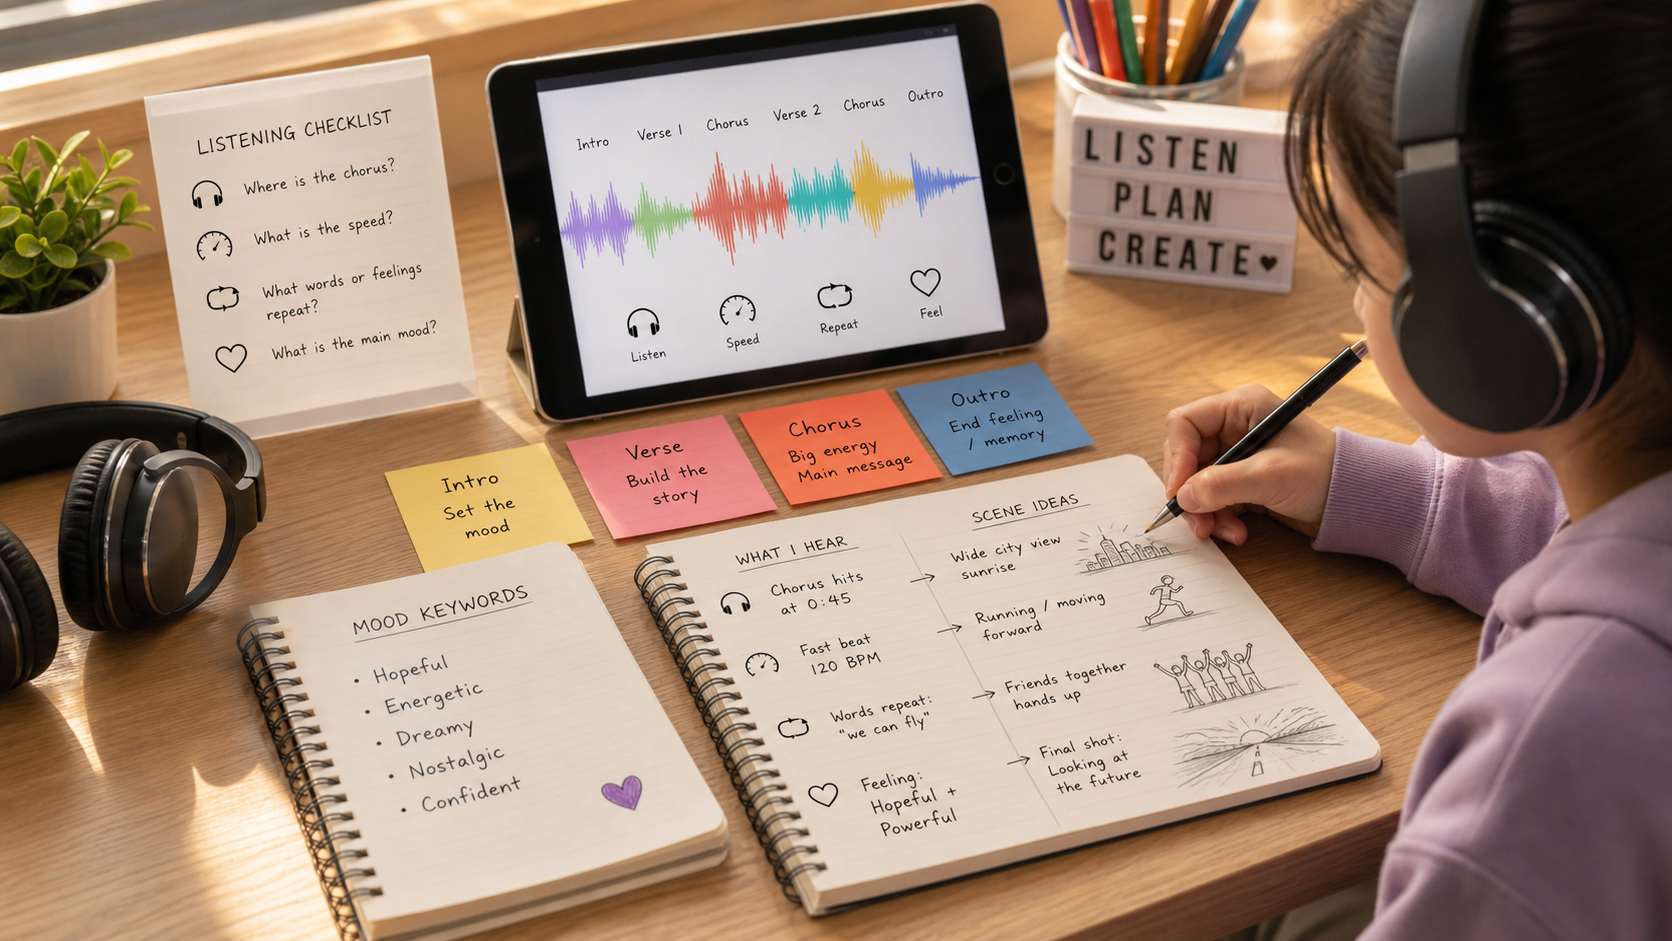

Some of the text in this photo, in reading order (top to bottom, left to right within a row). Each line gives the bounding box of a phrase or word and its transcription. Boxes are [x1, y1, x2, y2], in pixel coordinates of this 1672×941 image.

[843, 97, 886, 112] Chorus
[907, 88, 944, 103] Outro
[706, 117, 750, 132] Chorus
[772, 103, 822, 122] Verse 2
[196, 108, 392, 156] LISTENING CHECKLIST
[575, 137, 610, 151] Intro
[636, 123, 683, 142] Verse 1
[1084, 128, 1238, 174] LISTEN
[243, 156, 395, 196] Where is the chorus?
[1113, 180, 1213, 223] PLAN
[253, 209, 393, 246] What is the speed?
[1098, 228, 1251, 277] CREATE
[261, 263, 423, 299] What words or feelings
[266, 298, 319, 324] repeat?
[919, 304, 944, 320] Feel
[271, 319, 437, 361] What is the main mood?
[819, 318, 859, 337] Repeat
[726, 332, 761, 352] Speed
[630, 349, 667, 363] Listen
[951, 389, 1011, 407] Outro
[788, 417, 862, 437] Chorus
[948, 408, 1044, 433] End feeling
[624, 443, 684, 461] Verse
[969, 429, 1045, 451] / memory
[787, 440, 877, 466] Big energy
[626, 464, 709, 489] Build the
[797, 455, 913, 484] Main message
[440, 474, 499, 494] Intro
[443, 497, 516, 521] Set the
[652, 489, 699, 505] story
[971, 493, 1079, 524] SCENE IDEAS
[464, 518, 511, 540] mood
[734, 535, 848, 566] WHAT I HEAR
[949, 536, 1061, 563] Wide city view
[770, 571, 864, 597] Chorus hits
[961, 563, 1017, 580] sunrise
[352, 584, 529, 636] MOOD KEYWORDS
[780, 591, 852, 616] at 0:45
[974, 593, 1106, 625] Running / moving
[982, 619, 1043, 642] forward
[799, 633, 871, 657] Fast beat
[372, 654, 449, 685] Hopeful
[810, 651, 882, 676] 120 BPM
[1004, 662, 1127, 694] Friends together
[384, 683, 484, 715] Energetic
[829, 694, 933, 723] Words repeat:
[1012, 690, 1082, 711] hands up
[395, 720, 473, 747] Dreamy
[873, 723, 899, 735] can
[1038, 733, 1122, 759] Final shot:
[408, 747, 505, 780] Nostalgic
[1047, 749, 1129, 777] Looking at
[421, 775, 521, 813] Confident
[860, 771, 923, 793] Feeling:
[1056, 770, 1142, 795] the future
[870, 787, 957, 816] Hopeful +
[879, 806, 958, 837] Powerful
